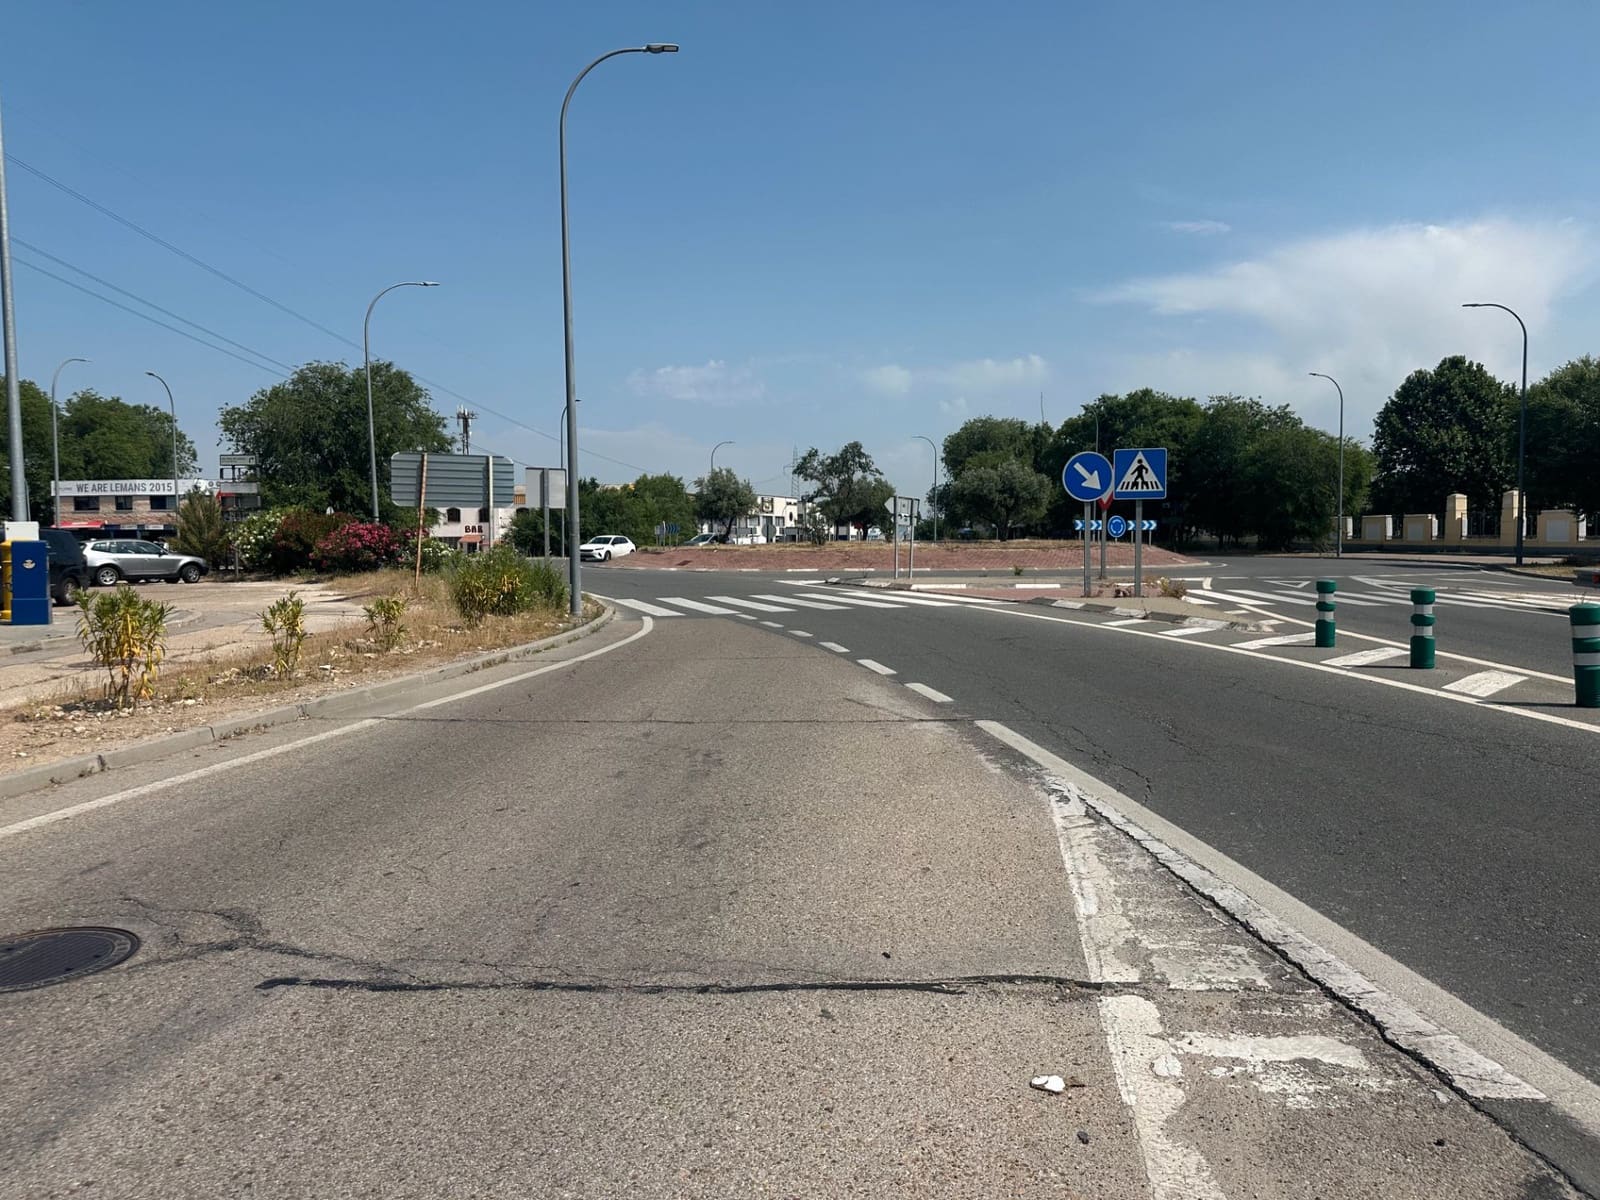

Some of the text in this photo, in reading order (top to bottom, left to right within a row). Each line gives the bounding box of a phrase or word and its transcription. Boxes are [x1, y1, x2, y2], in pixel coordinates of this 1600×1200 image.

[76, 482, 173, 493] WE ARE LEMANS 2015
[464, 525, 483, 533] BAR
